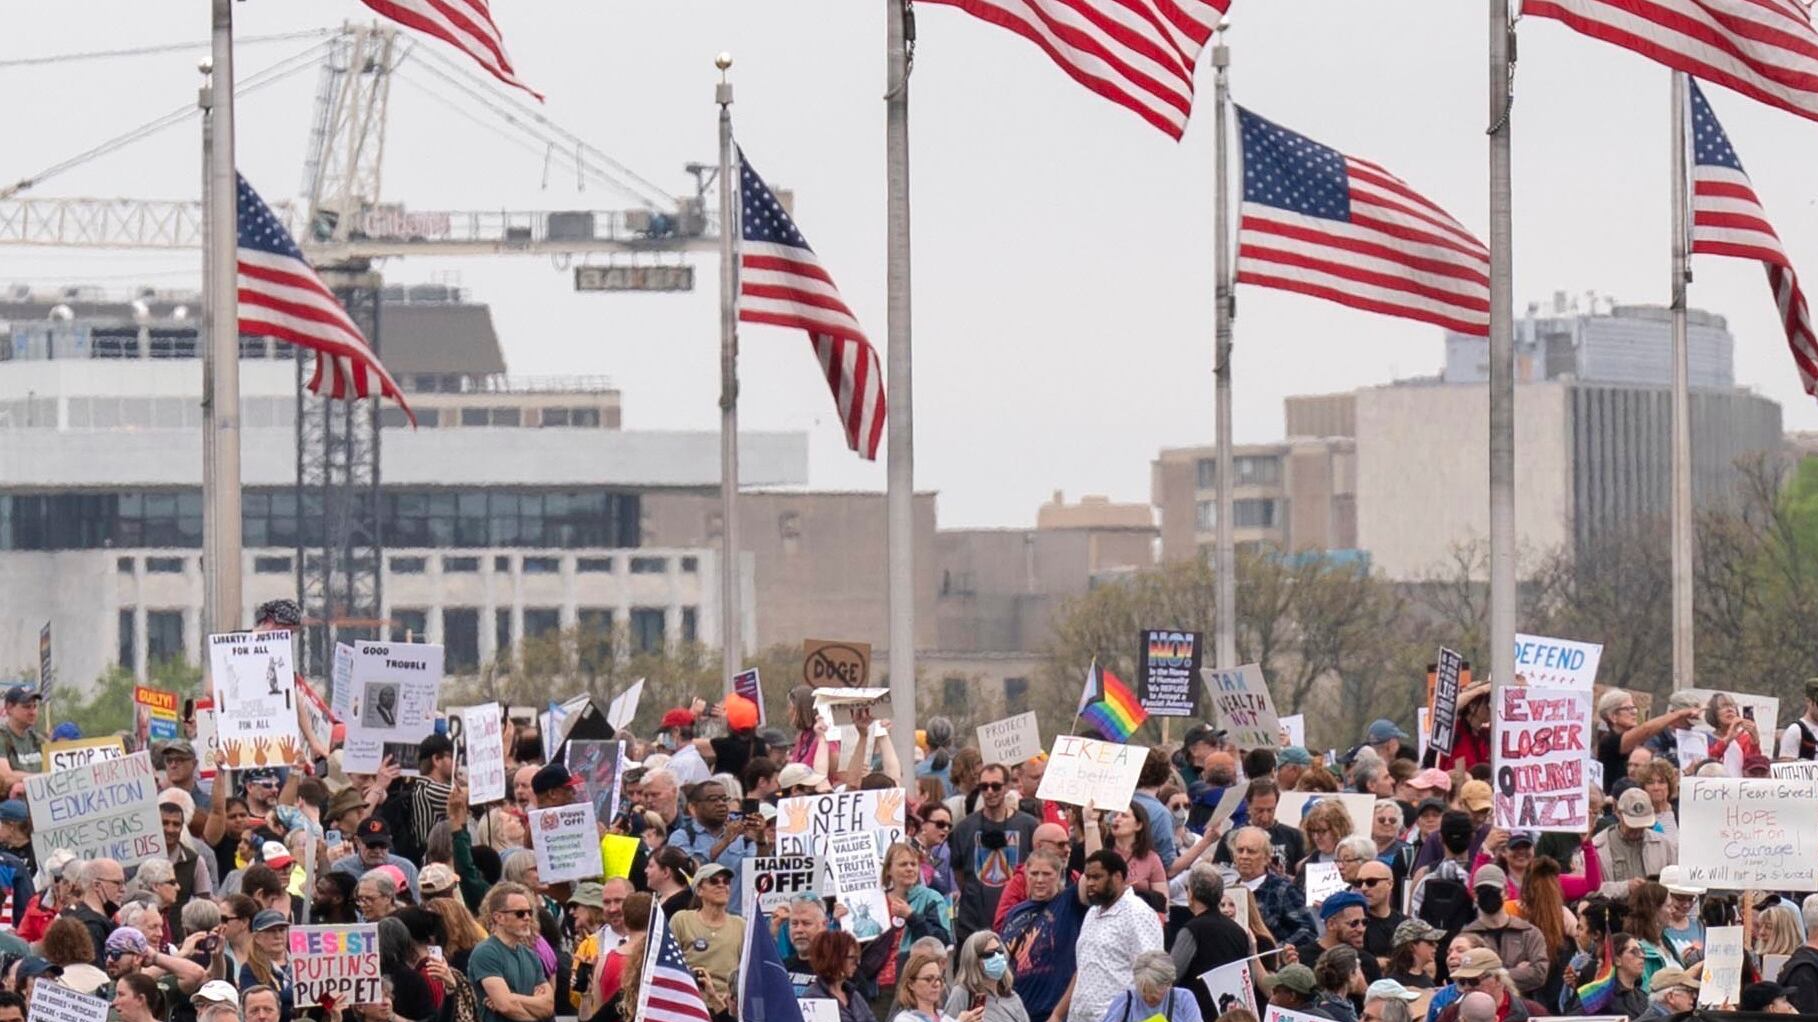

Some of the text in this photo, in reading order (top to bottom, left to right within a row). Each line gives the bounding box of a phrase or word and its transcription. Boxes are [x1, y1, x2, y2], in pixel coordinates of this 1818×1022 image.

[213, 631, 290, 645] LIBERTY JUSTICE
[232, 645, 269, 656] FOR ALL
[362, 646, 389, 656] GOOD
[1148, 631, 1195, 668] NO!
[385, 660, 427, 670] TROUBLE
[813, 658, 860, 682] DOGE
[1212, 673, 1248, 692] TAX
[138, 689, 173, 707] GUILTY!
[1500, 687, 1585, 722] EVIL
[985, 716, 1028, 738] PROTECT
[1230, 710, 1259, 728] NOT
[1058, 738, 1129, 766] IKEA
[1501, 723, 1585, 759] LOSER
[92, 754, 149, 785] HURTIN
[1498, 758, 1582, 797] OLIGARCH
[50, 781, 144, 821] EDUKATON
[1693, 780, 1731, 802] Fork
[1739, 782, 1767, 799] Fear
[818, 793, 864, 815] OFF
[1495, 791, 1586, 827] NAZI
[813, 812, 863, 835] NIH
[1726, 806, 1777, 827] HOPE
[43, 813, 143, 851] MORE SIGNS
[134, 834, 161, 858] DIS
[834, 840, 873, 854] VALUES
[754, 857, 814, 871] HANDS
[838, 859, 875, 873] TRUTH
[1689, 869, 1704, 881] We
[755, 871, 813, 895] OFF!
[840, 880, 878, 893] LIBERTY
[290, 931, 376, 955] RESIST
[294, 952, 378, 982] PUTIN'S
[294, 977, 380, 1005] PUPPET
